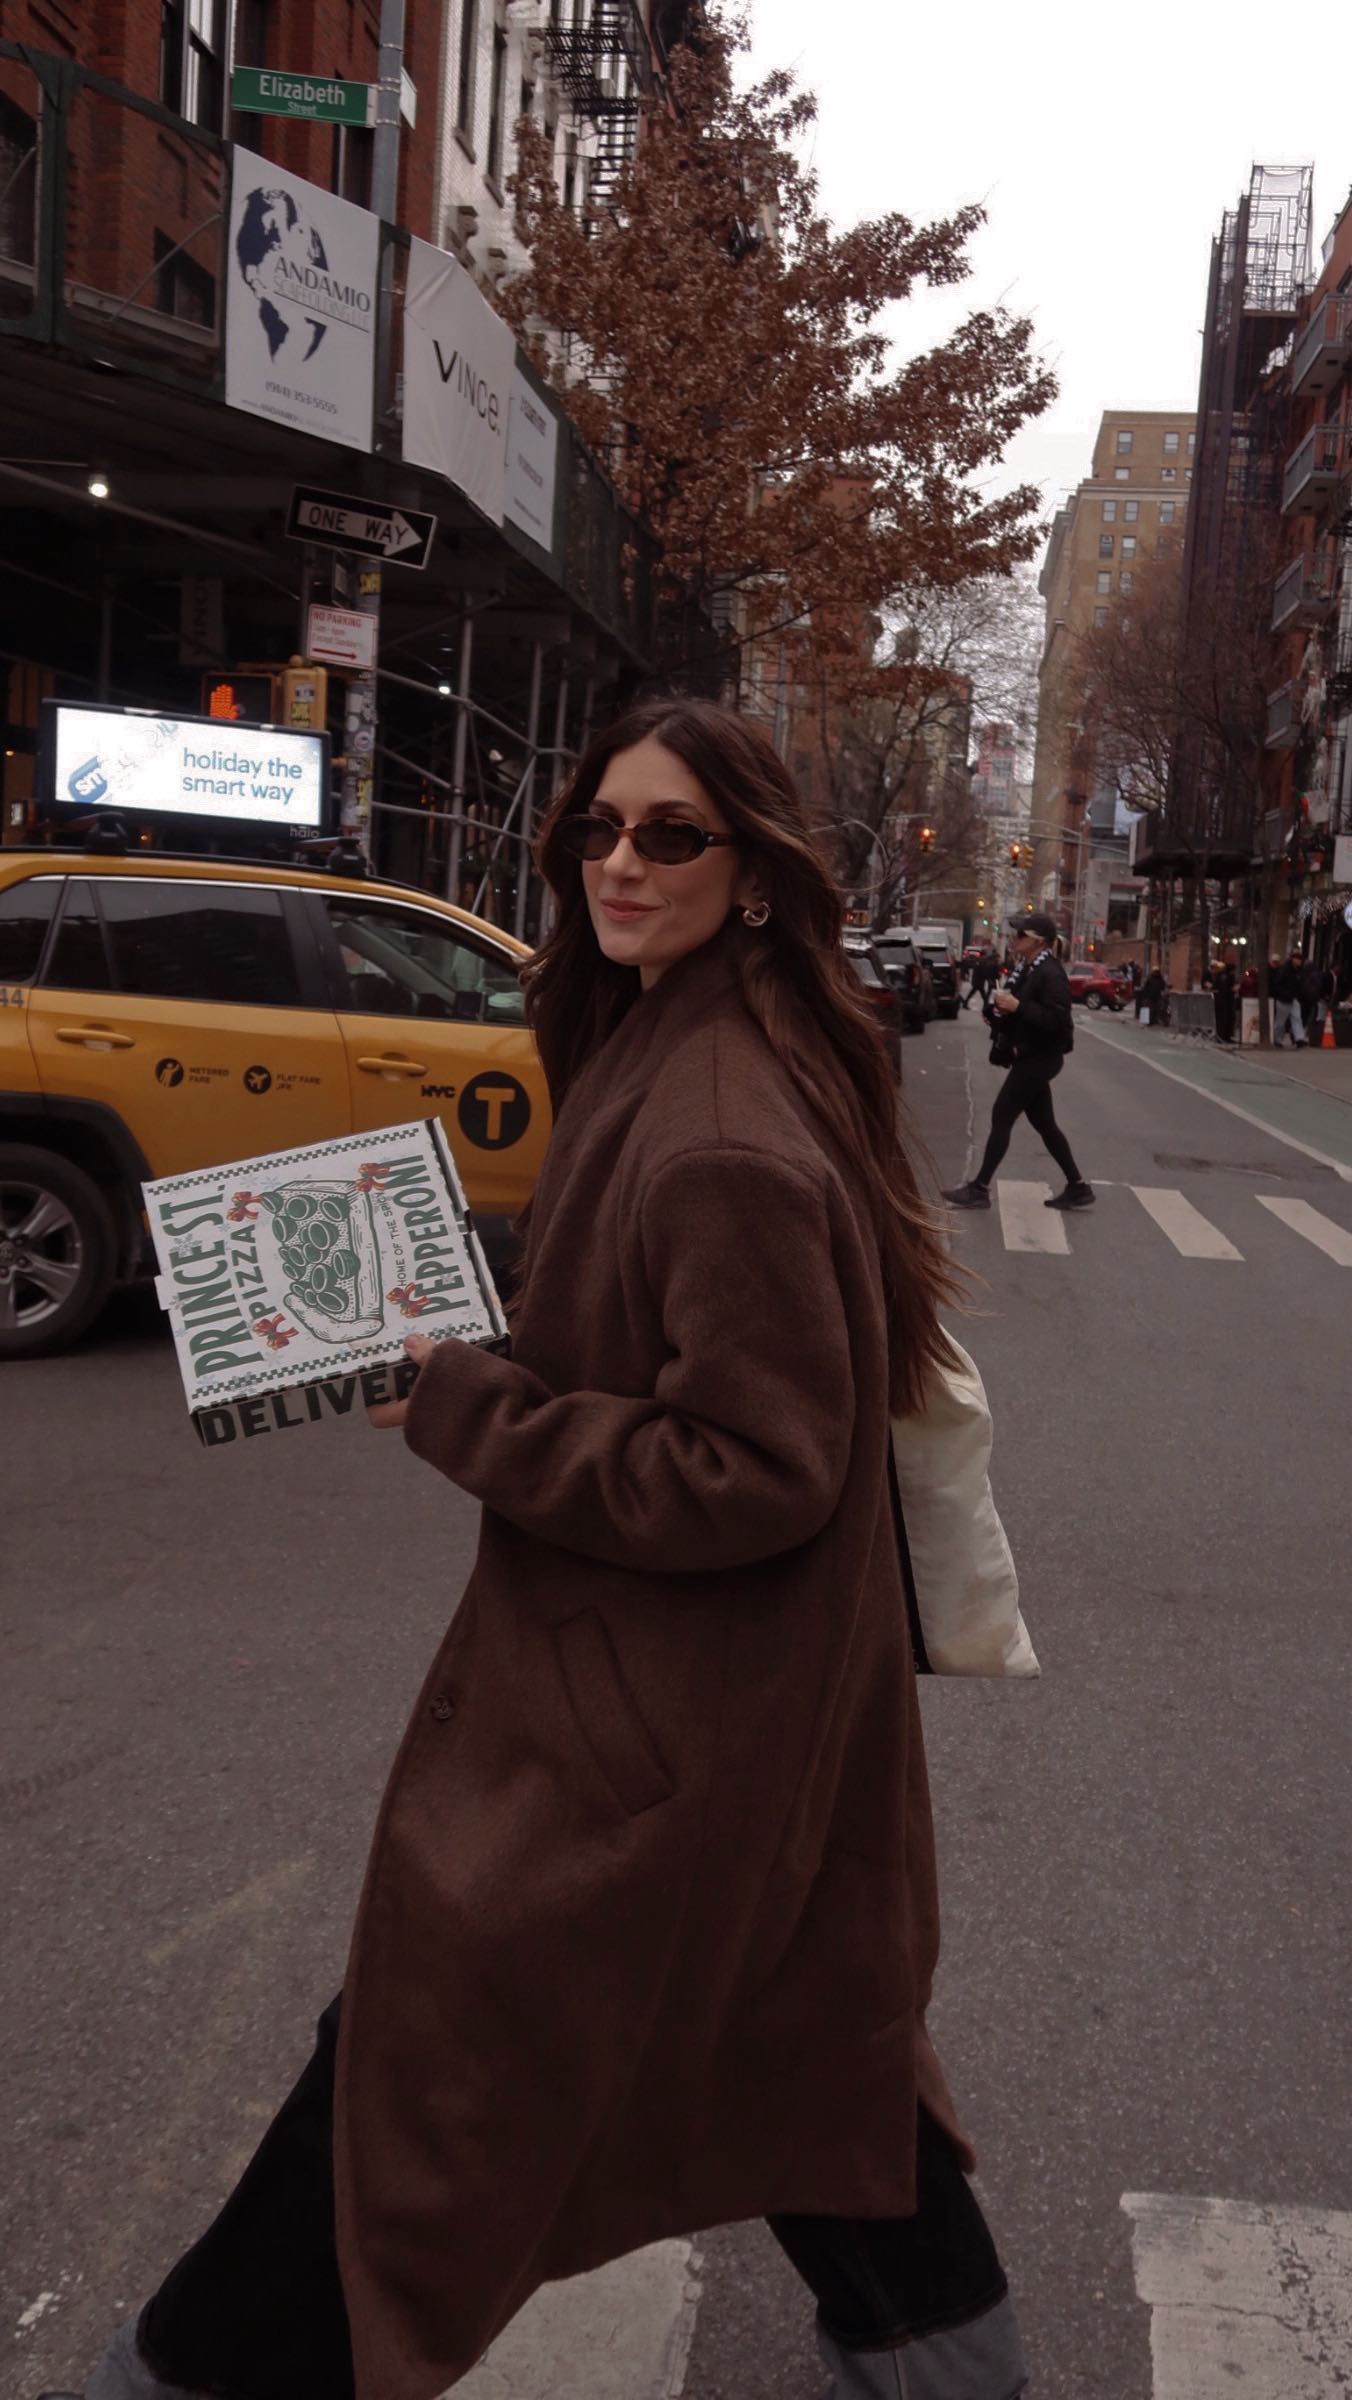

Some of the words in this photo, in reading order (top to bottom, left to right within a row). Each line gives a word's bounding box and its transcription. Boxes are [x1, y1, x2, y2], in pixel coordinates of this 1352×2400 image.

[259, 75, 346, 106] Elizabeth
[287, 102, 317, 115] Street
[274, 256, 371, 312] ANDAMIO
[308, 506, 348, 532] ONE
[365, 518, 409, 545] WAY
[313, 611, 325, 621] NO
[327, 613, 362, 628] PARKING
[183, 747, 262, 778] holiday
[267, 757, 303, 779] the
[182, 775, 245, 797] smart
[250, 782, 294, 805] way
[189, 1067, 230, 1076] METERED
[189, 1076, 211, 1084] FARE
[276, 1074, 297, 1083] FLAT
[300, 1076, 321, 1085] FARE
[421, 1085, 456, 1098] NYC
[376, 1191, 394, 1216] SPICY
[374, 1154, 471, 1318] PEPPERONI
[386, 1218, 401, 1240] THE
[393, 1243, 404, 1255] OF
[230, 1224, 277, 1321] PIZZA
[396, 1255, 408, 1287] HOME
[168, 1239, 264, 1378] PRINCE
